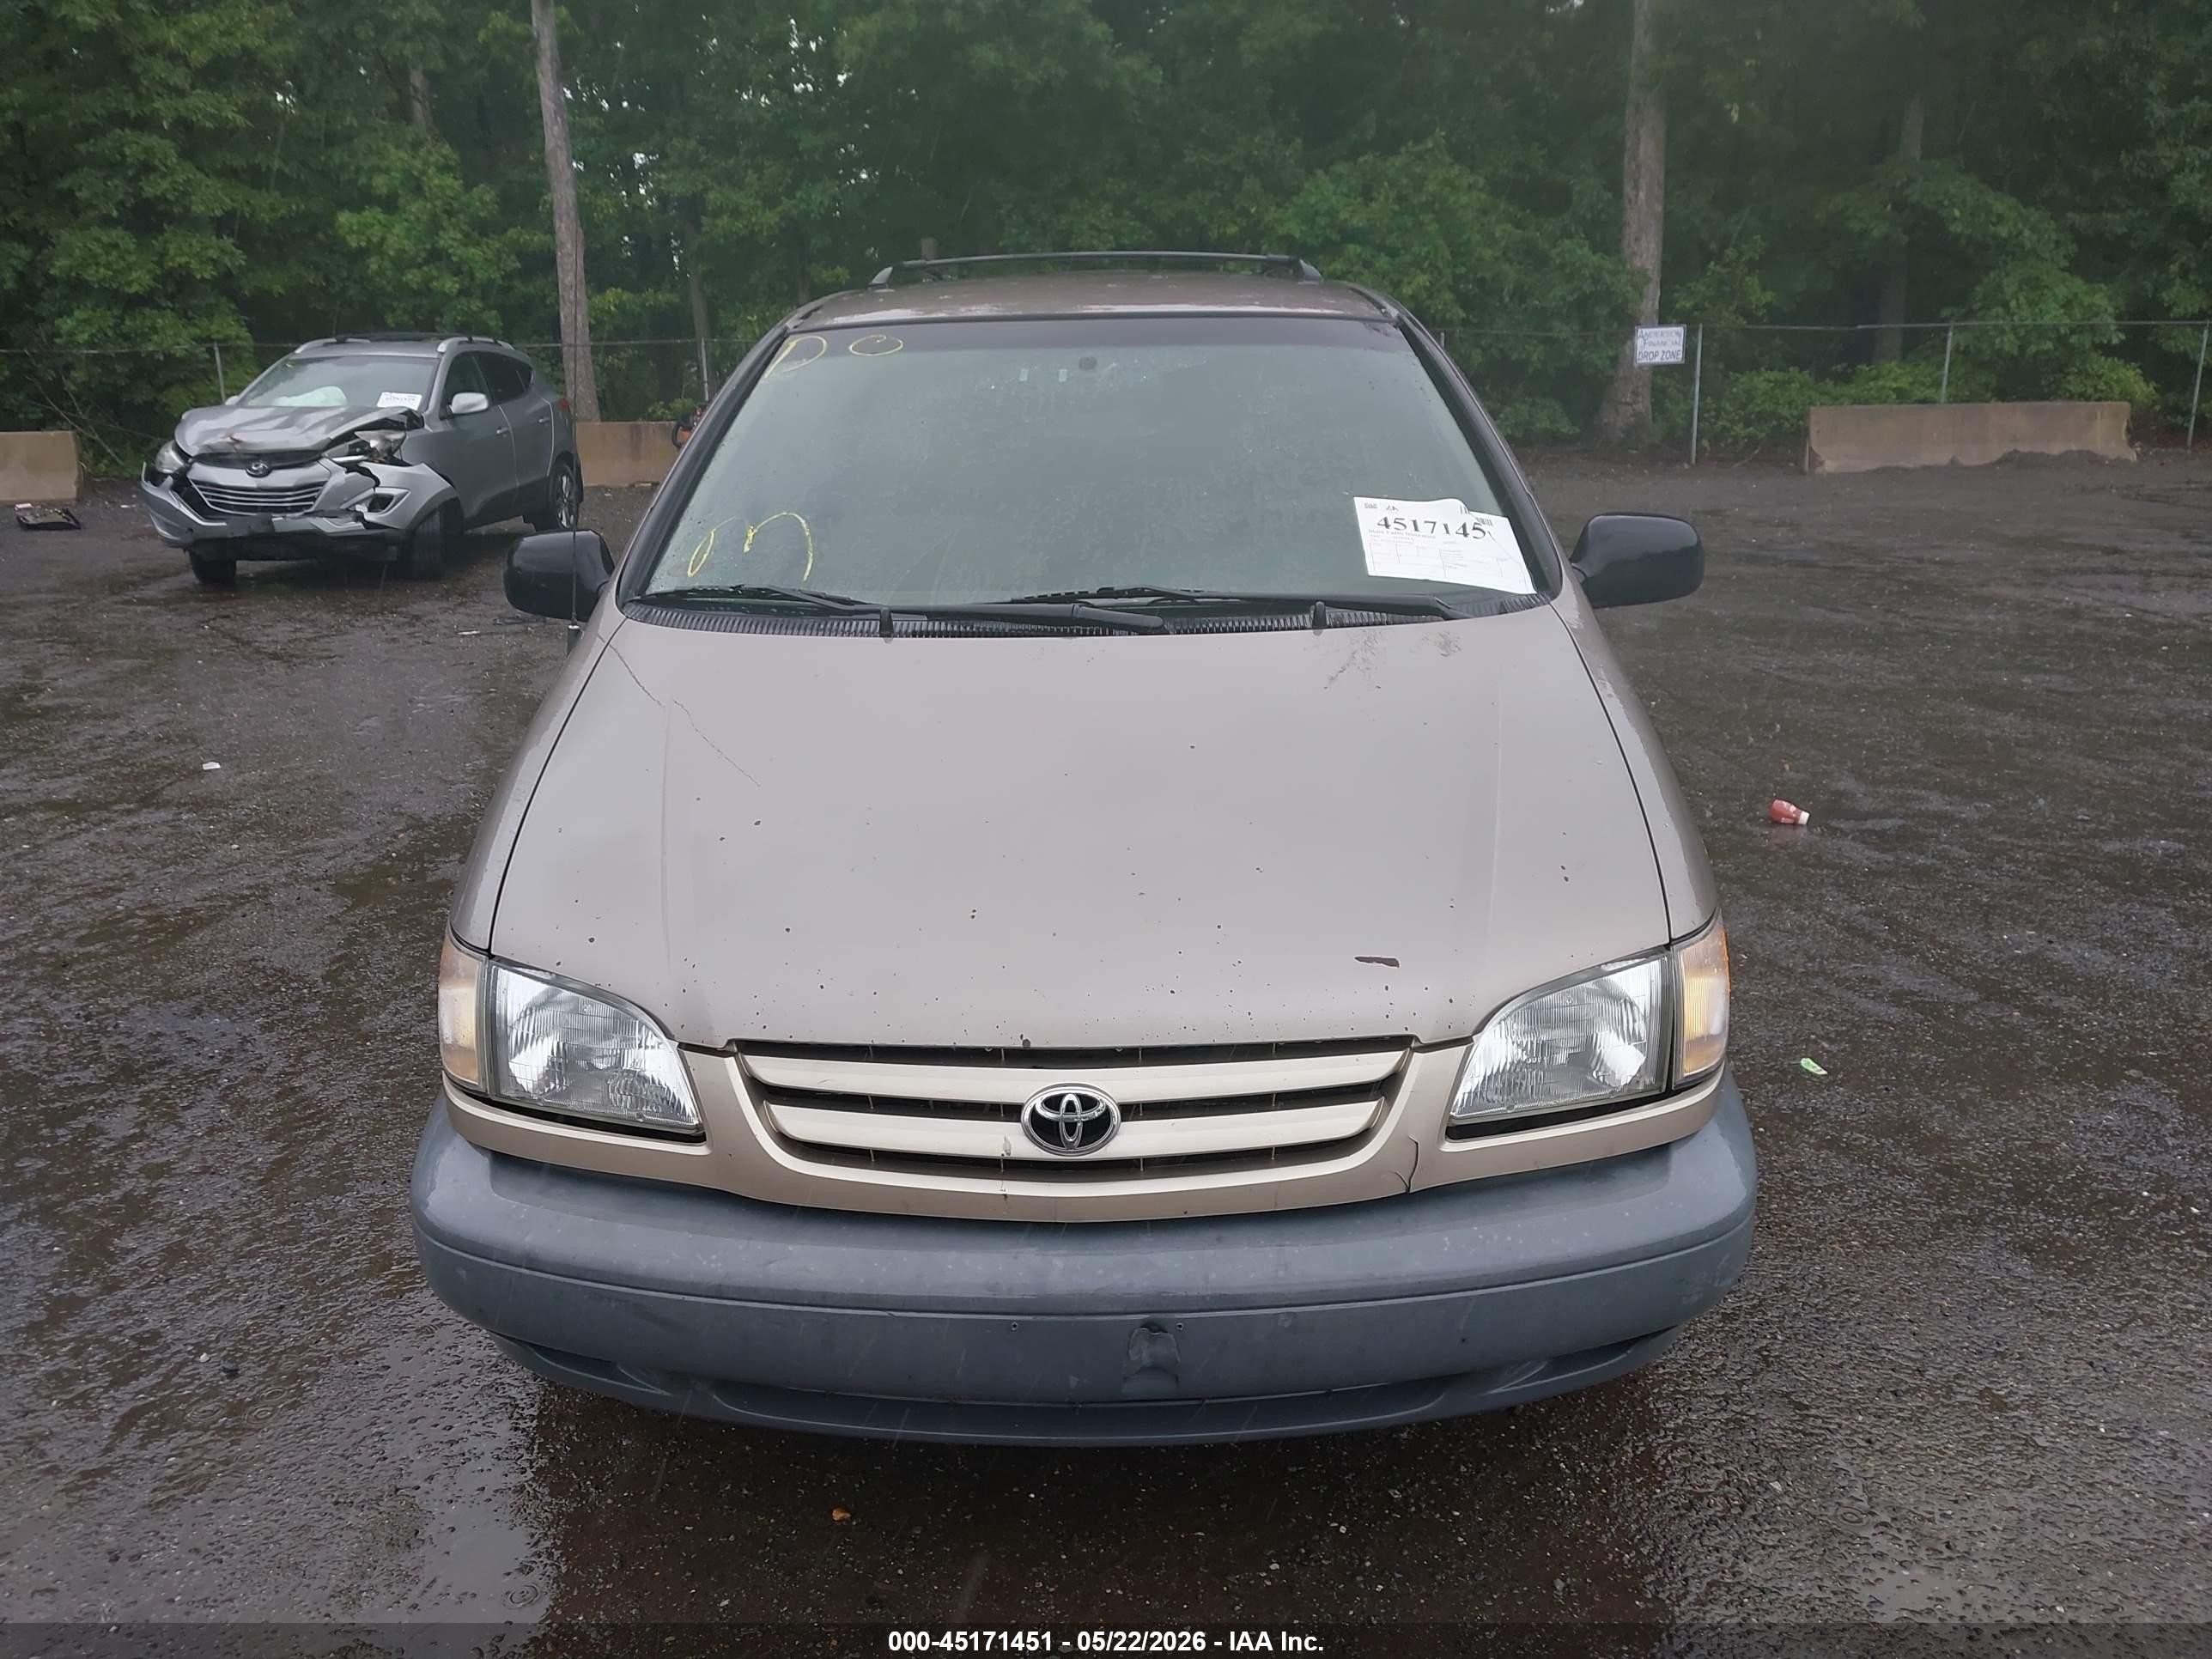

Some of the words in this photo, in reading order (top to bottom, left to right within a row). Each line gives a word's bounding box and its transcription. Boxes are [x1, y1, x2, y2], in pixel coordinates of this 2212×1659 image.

[1638, 350, 1660, 361] DROP
[1660, 349, 1681, 361] ZONE
[1376, 516, 1486, 539] 4517145
